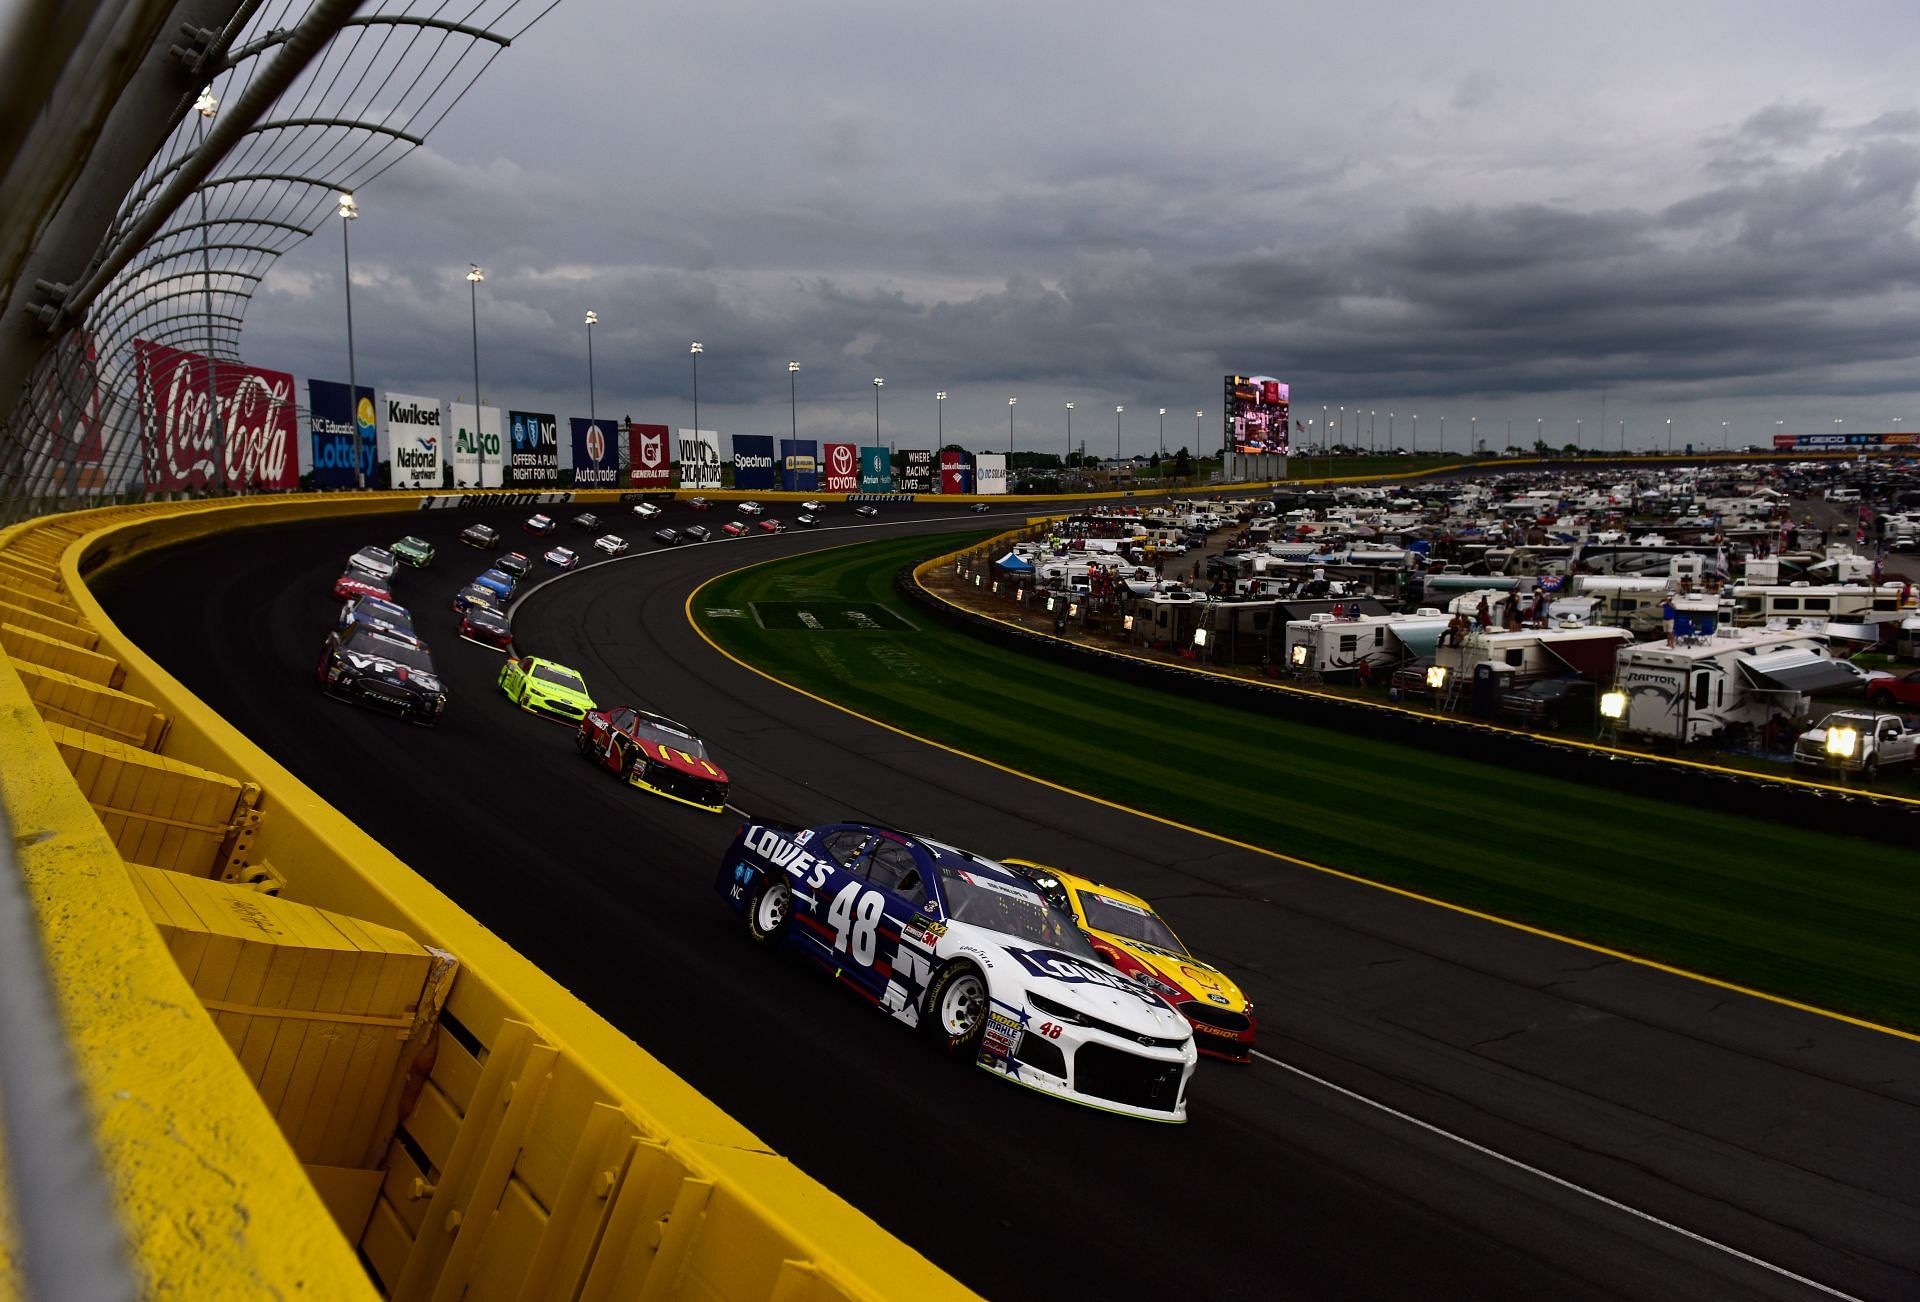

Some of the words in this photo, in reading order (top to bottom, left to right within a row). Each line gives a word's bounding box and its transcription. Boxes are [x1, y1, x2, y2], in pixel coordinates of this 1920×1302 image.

[165, 359, 290, 481] Coca-Cola
[389, 400, 440, 426] Kwikset
[312, 418, 325, 432] NC
[325, 419, 355, 435] Educatio
[540, 423, 557, 445] NC
[313, 434, 376, 476] Lottery
[397, 445, 437, 468] National
[679, 439, 705, 461] VOLVO
[908, 452, 930, 463] WHERE
[512, 454, 537, 466] OFFERS
[537, 454, 543, 466] A
[543, 455, 557, 466] PLAN
[735, 453, 772, 470] Spectrum
[410, 469, 436, 480] Hardware
[513, 468, 533, 480] RIGHT
[533, 468, 546, 480] FOR
[546, 468, 558, 480] YOU
[631, 470, 657, 479] GENERAL
[657, 469, 670, 478] TIRE
[680, 464, 721, 482] EXCAVATORS
[906, 466, 929, 477] RACING
[991, 468, 1006, 479] SOLAR
[828, 477, 857, 489] TOYOTA
[458, 493, 540, 508] CHARLOTTE
[1627, 672, 1677, 687] RAPTOR
[743, 825, 835, 889] LOWE'S
[730, 884, 744, 900] NC
[827, 881, 885, 967] 48
[922, 931, 940, 948] 3M
[988, 1019, 1018, 1039] MAHLE
[991, 1012, 1022, 1030] MOOG
[1040, 1022, 1063, 1039] 48
